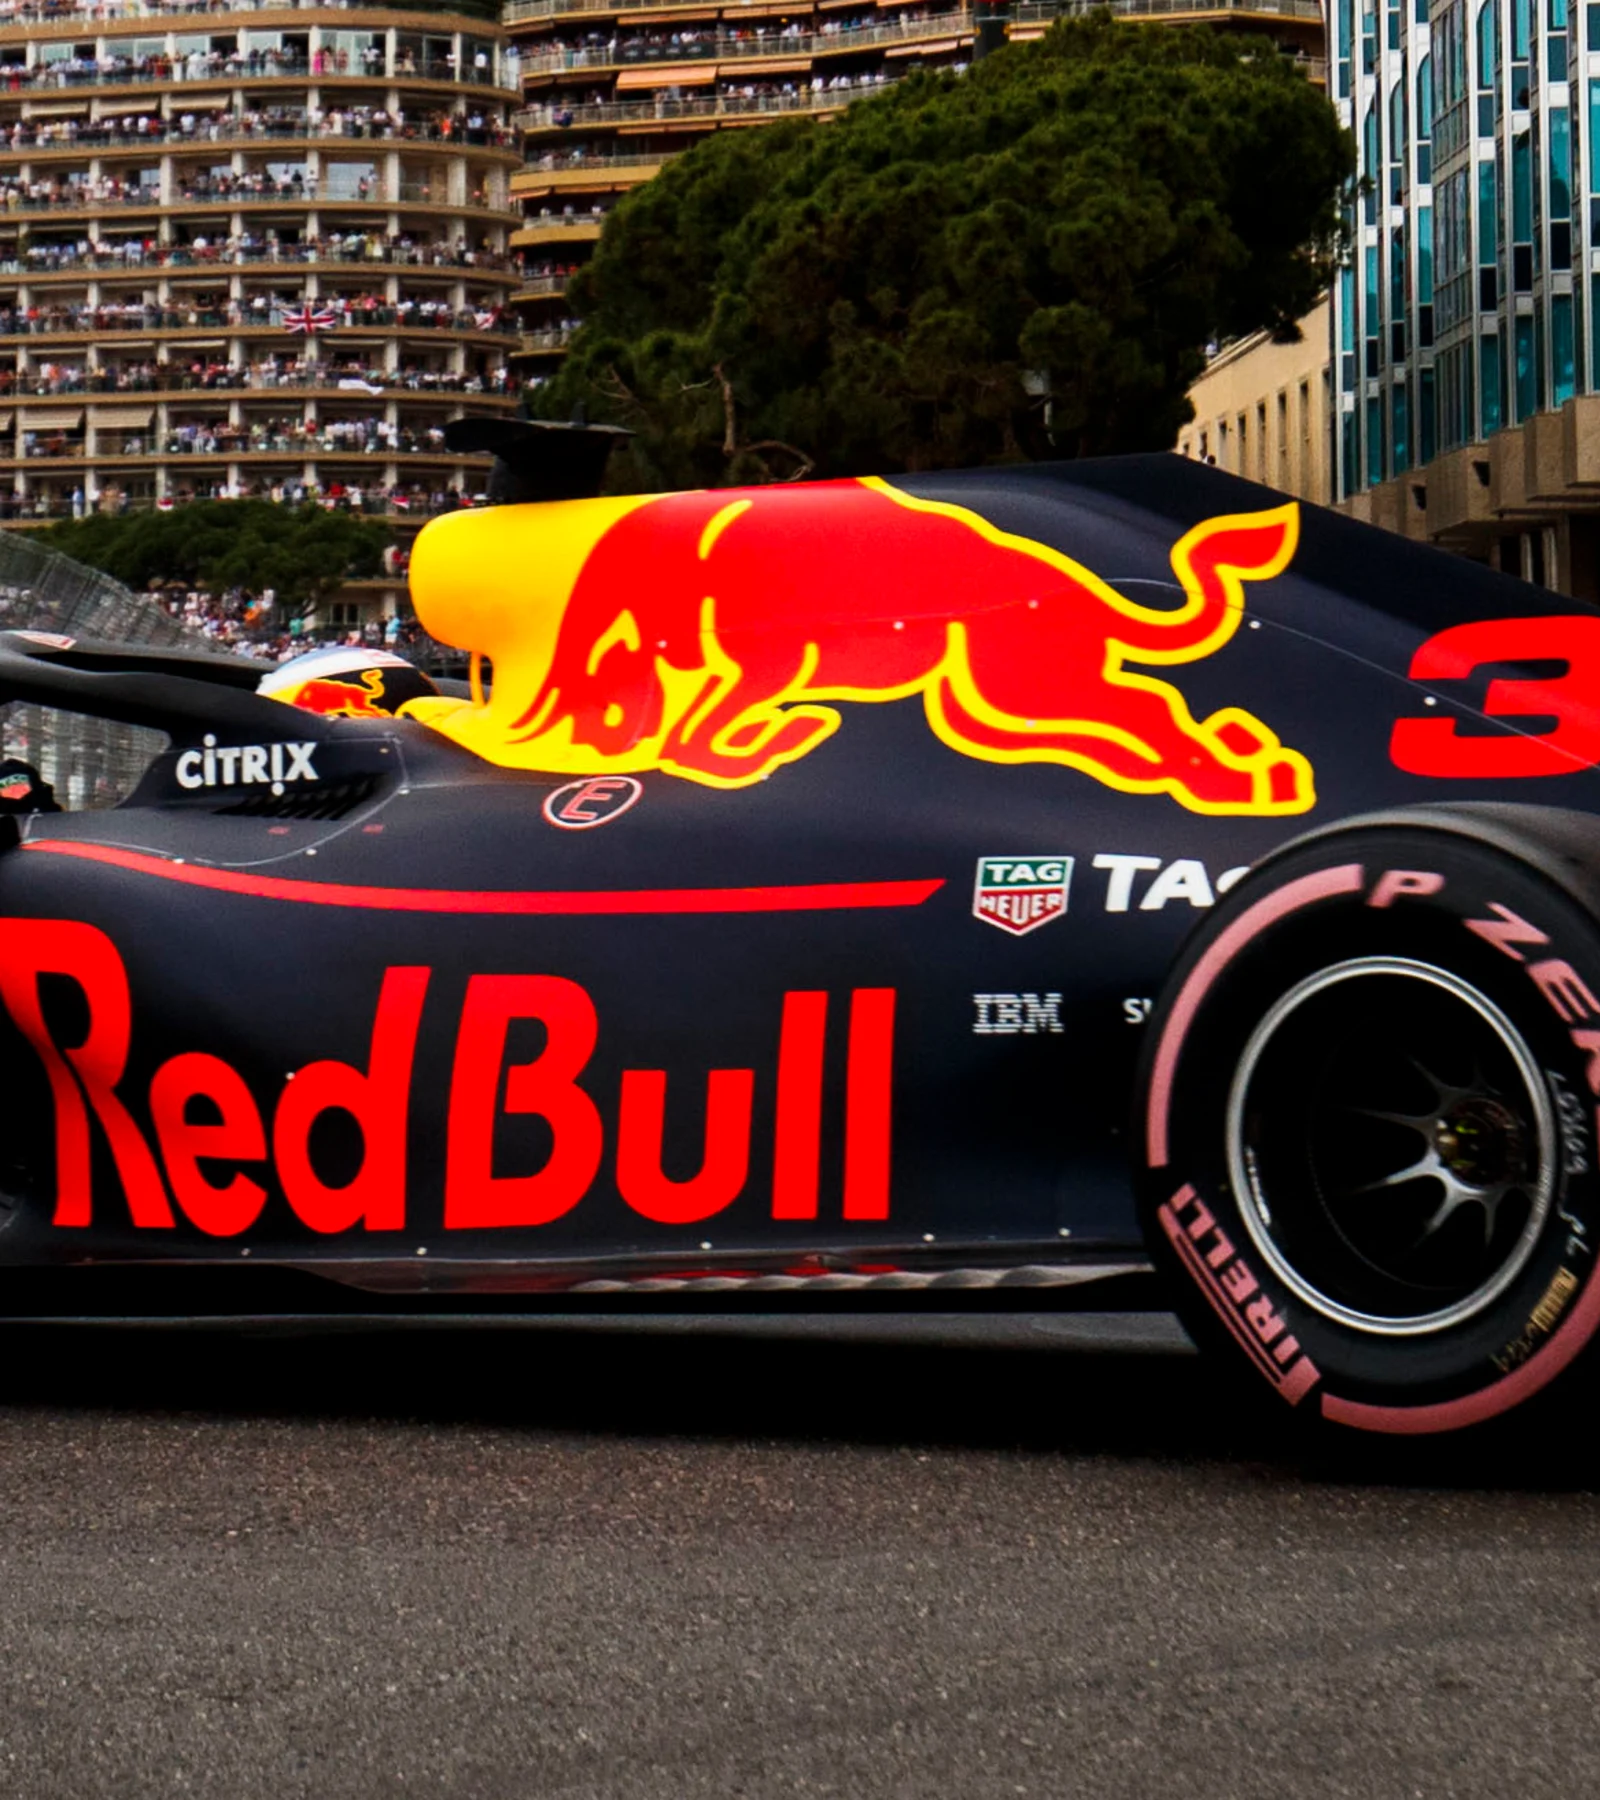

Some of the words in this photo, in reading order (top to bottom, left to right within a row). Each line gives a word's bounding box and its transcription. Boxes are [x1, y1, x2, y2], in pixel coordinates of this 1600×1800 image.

[985, 861, 1064, 884] TAG
[1366, 869, 1446, 908] P
[980, 891, 1064, 926] HEUER
[972, 993, 1064, 1034] IBM
[0, 917, 432, 1237] Red
[444, 973, 896, 1230] Bull
[1158, 1181, 1321, 1408] PIRELLI
